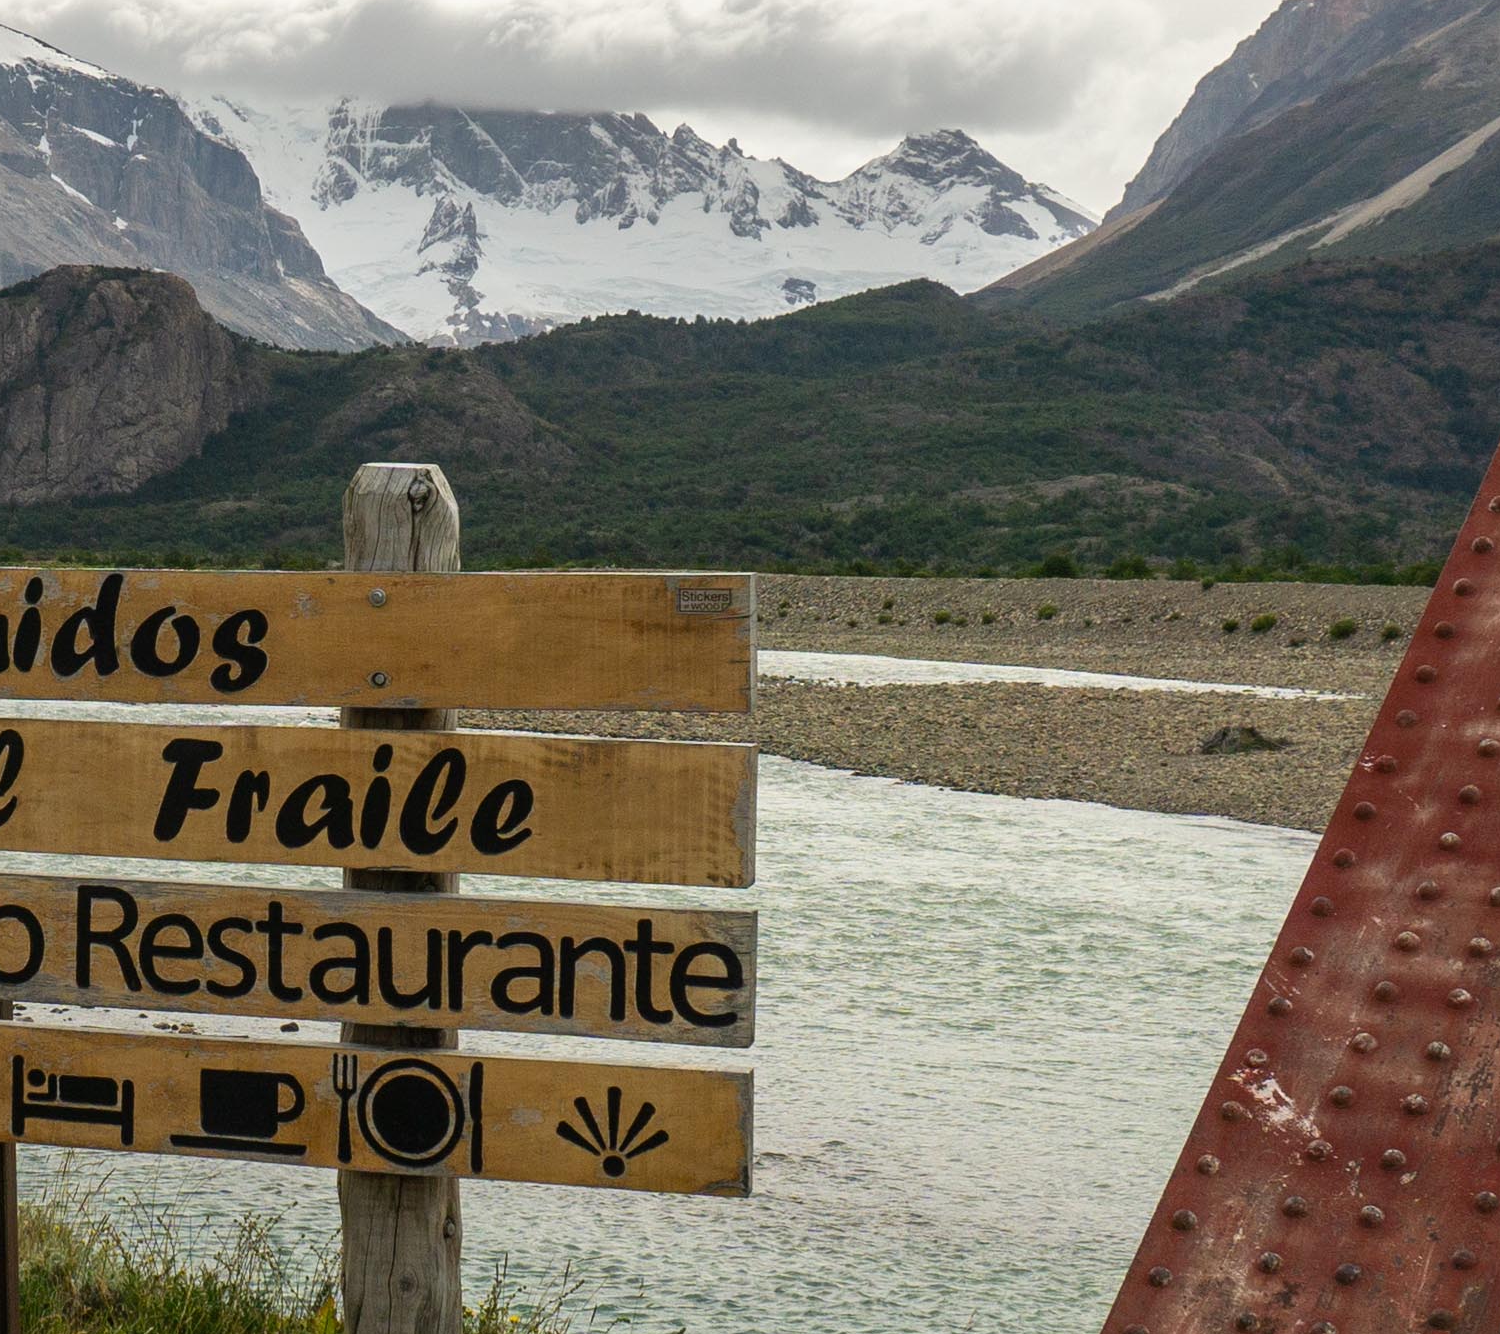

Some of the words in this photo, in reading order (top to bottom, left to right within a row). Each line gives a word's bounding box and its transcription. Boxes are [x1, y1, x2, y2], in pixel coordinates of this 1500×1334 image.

[682, 591, 729, 602] Stickers
[153, 738, 534, 856] Fraile
[75, 884, 744, 1029] Restaurante
